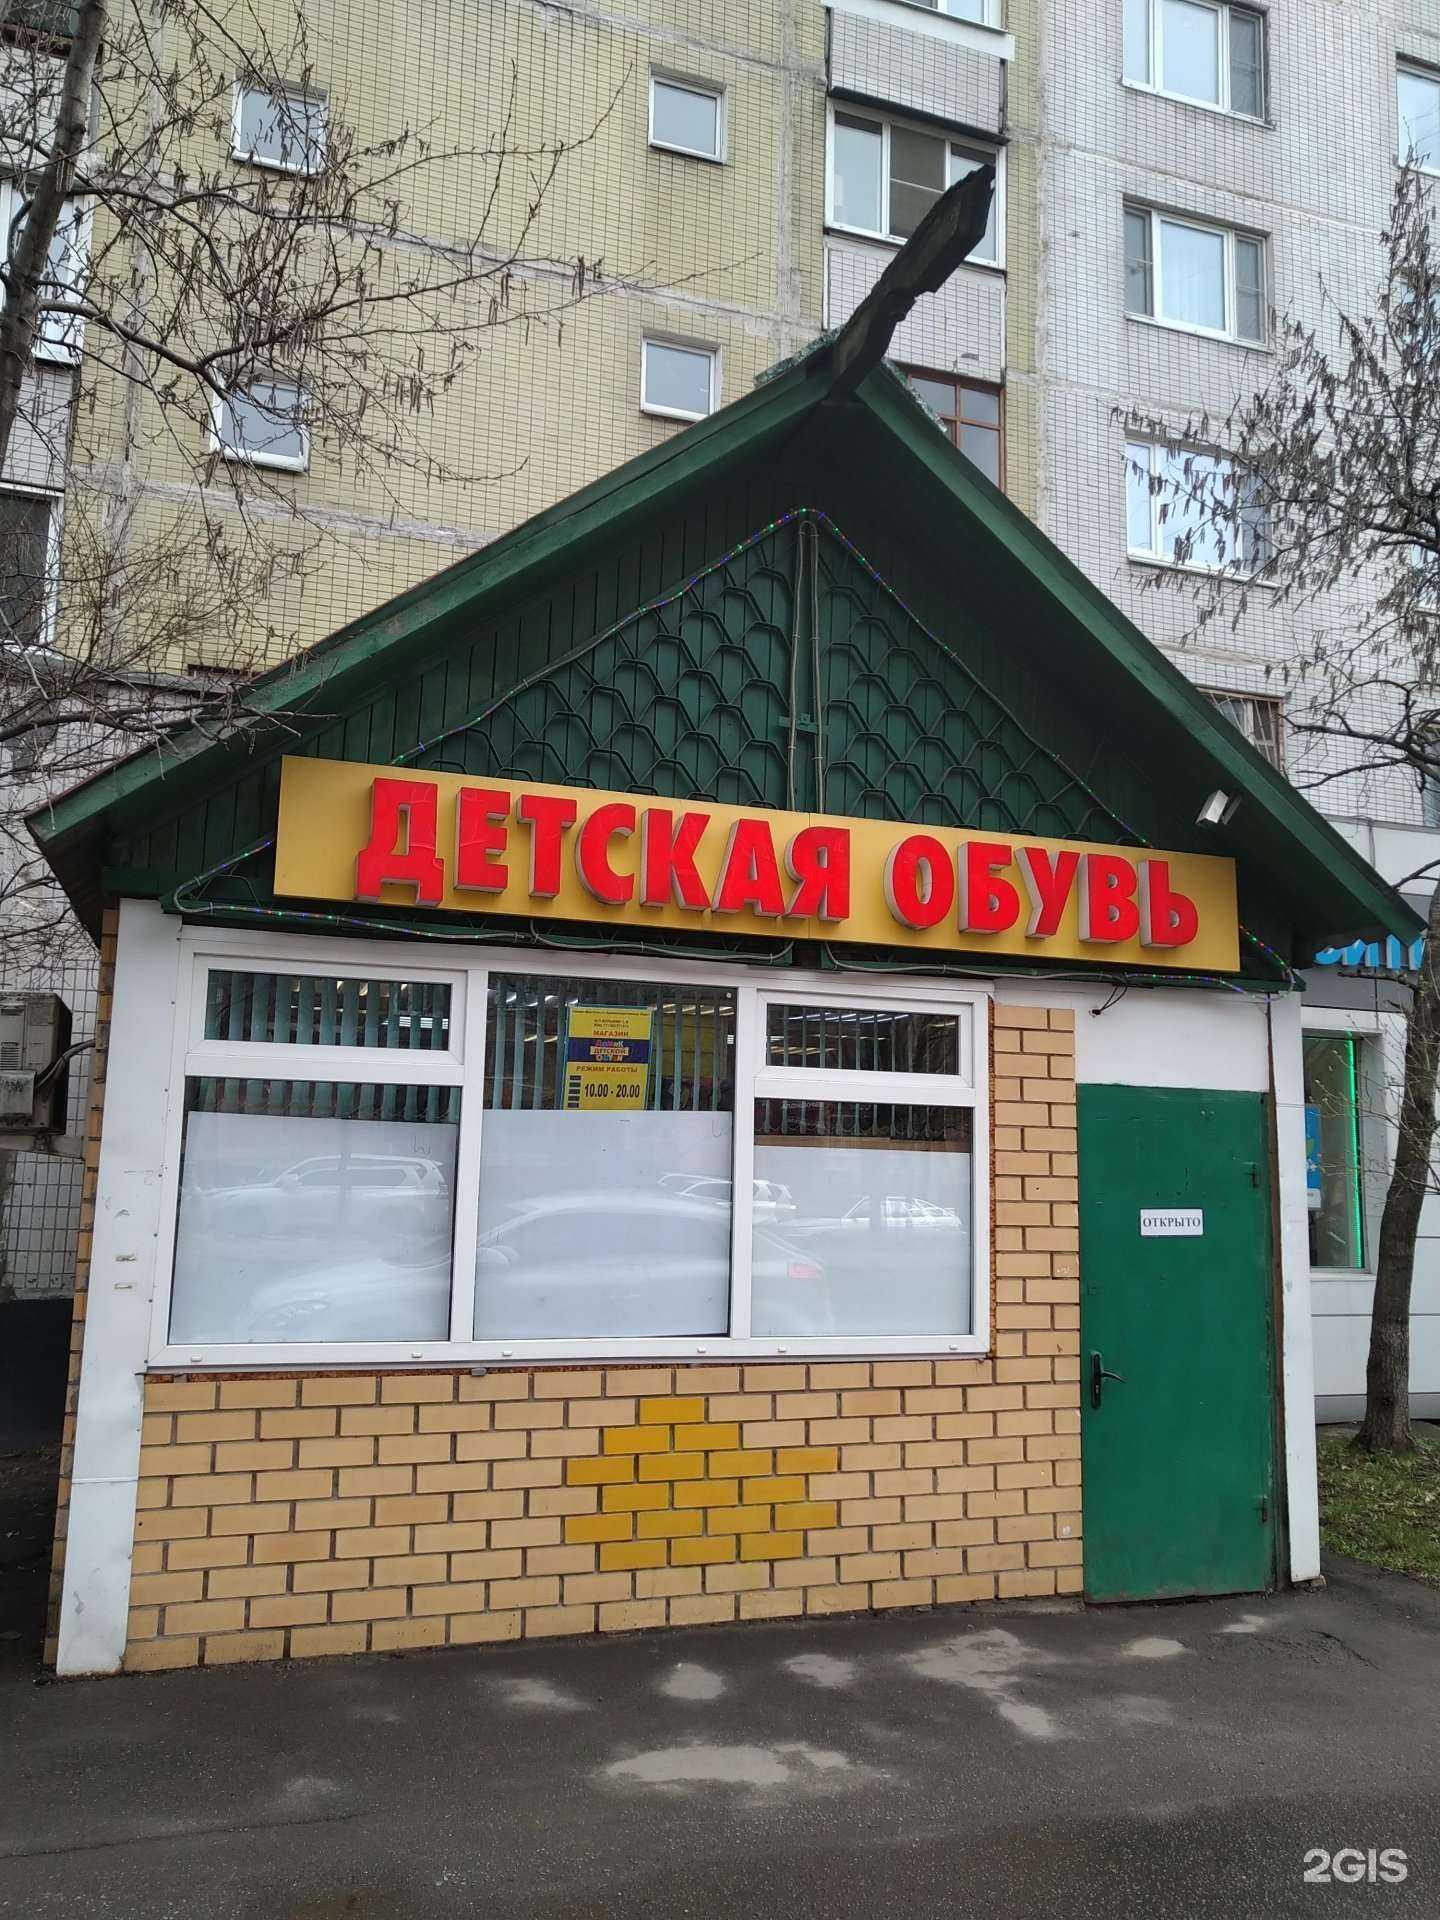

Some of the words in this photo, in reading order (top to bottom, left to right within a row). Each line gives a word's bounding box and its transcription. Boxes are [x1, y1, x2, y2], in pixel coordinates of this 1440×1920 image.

[355, 777, 850, 921] ДЕТСКАЯ
[884, 834, 1198, 947] ОБУВЬ
[585, 1083, 608, 1098] 10.00
[616, 1084, 640, 1098] 20.00
[1143, 1216, 1201, 1228] ОТКРЫТО
